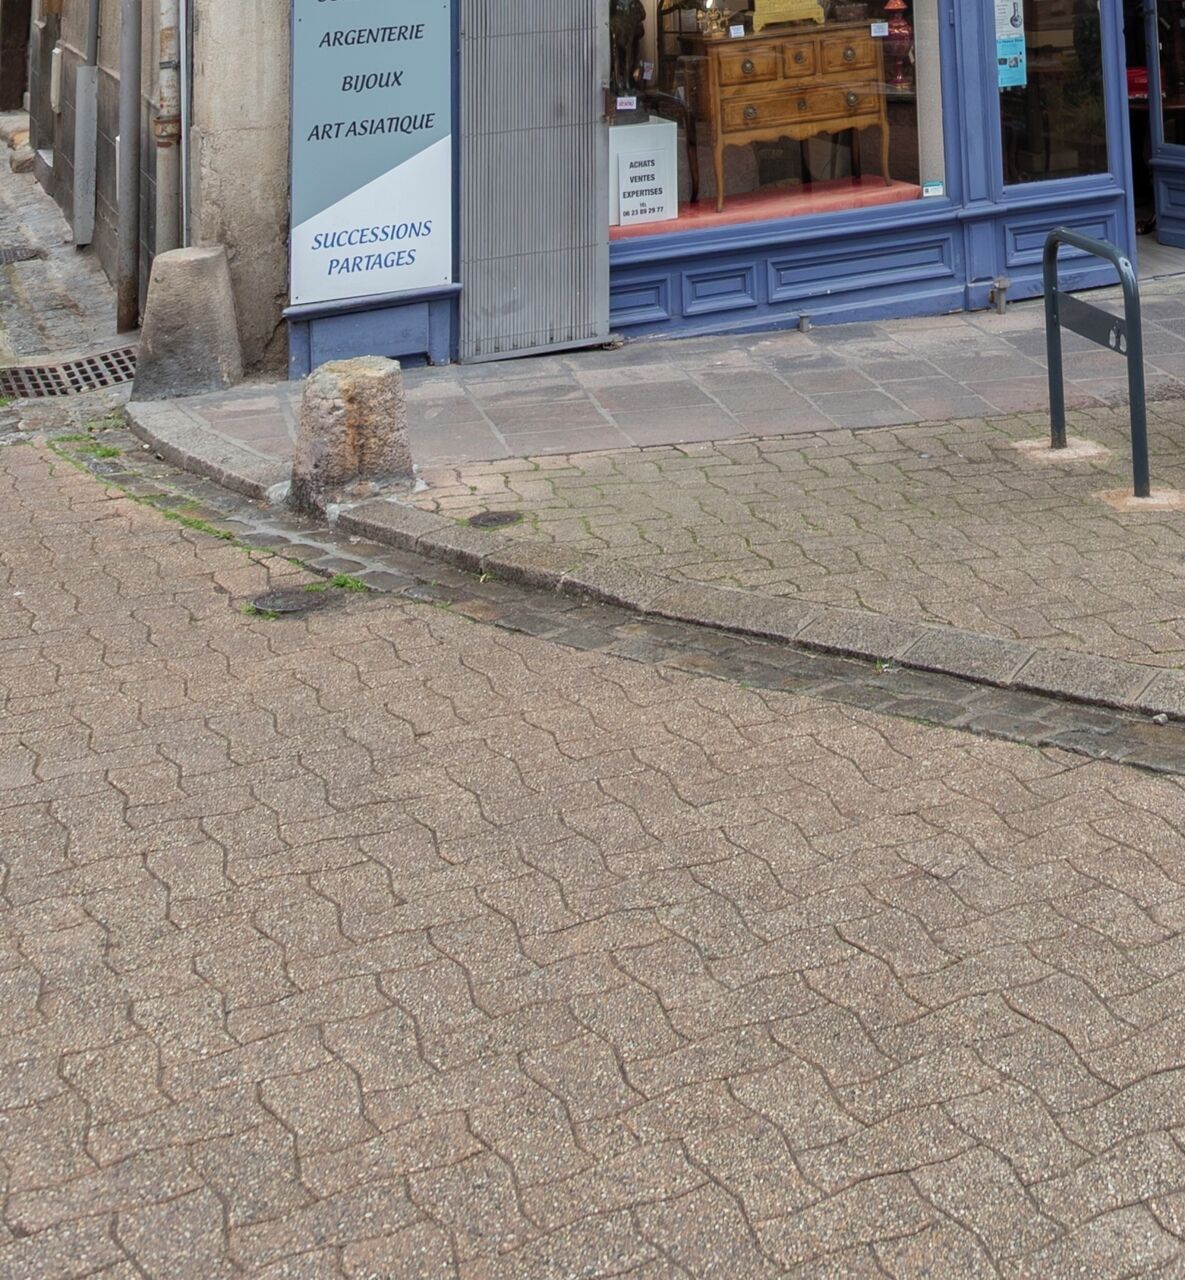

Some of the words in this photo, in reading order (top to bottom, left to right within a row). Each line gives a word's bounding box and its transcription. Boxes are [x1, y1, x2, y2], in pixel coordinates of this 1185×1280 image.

[319, 24, 425, 48] ARGENTERIE
[341, 70, 403, 93] BIJOUX
[307, 122, 345, 141] ART
[345, 113, 435, 137] ASIATIQUE
[629, 160, 655, 169] ACHATS
[630, 174, 655, 183] VENTES
[623, 188, 663, 199] EXPERTISES
[311, 220, 432, 250] SUCCESSIONS
[327, 249, 416, 275] PARTAGES
